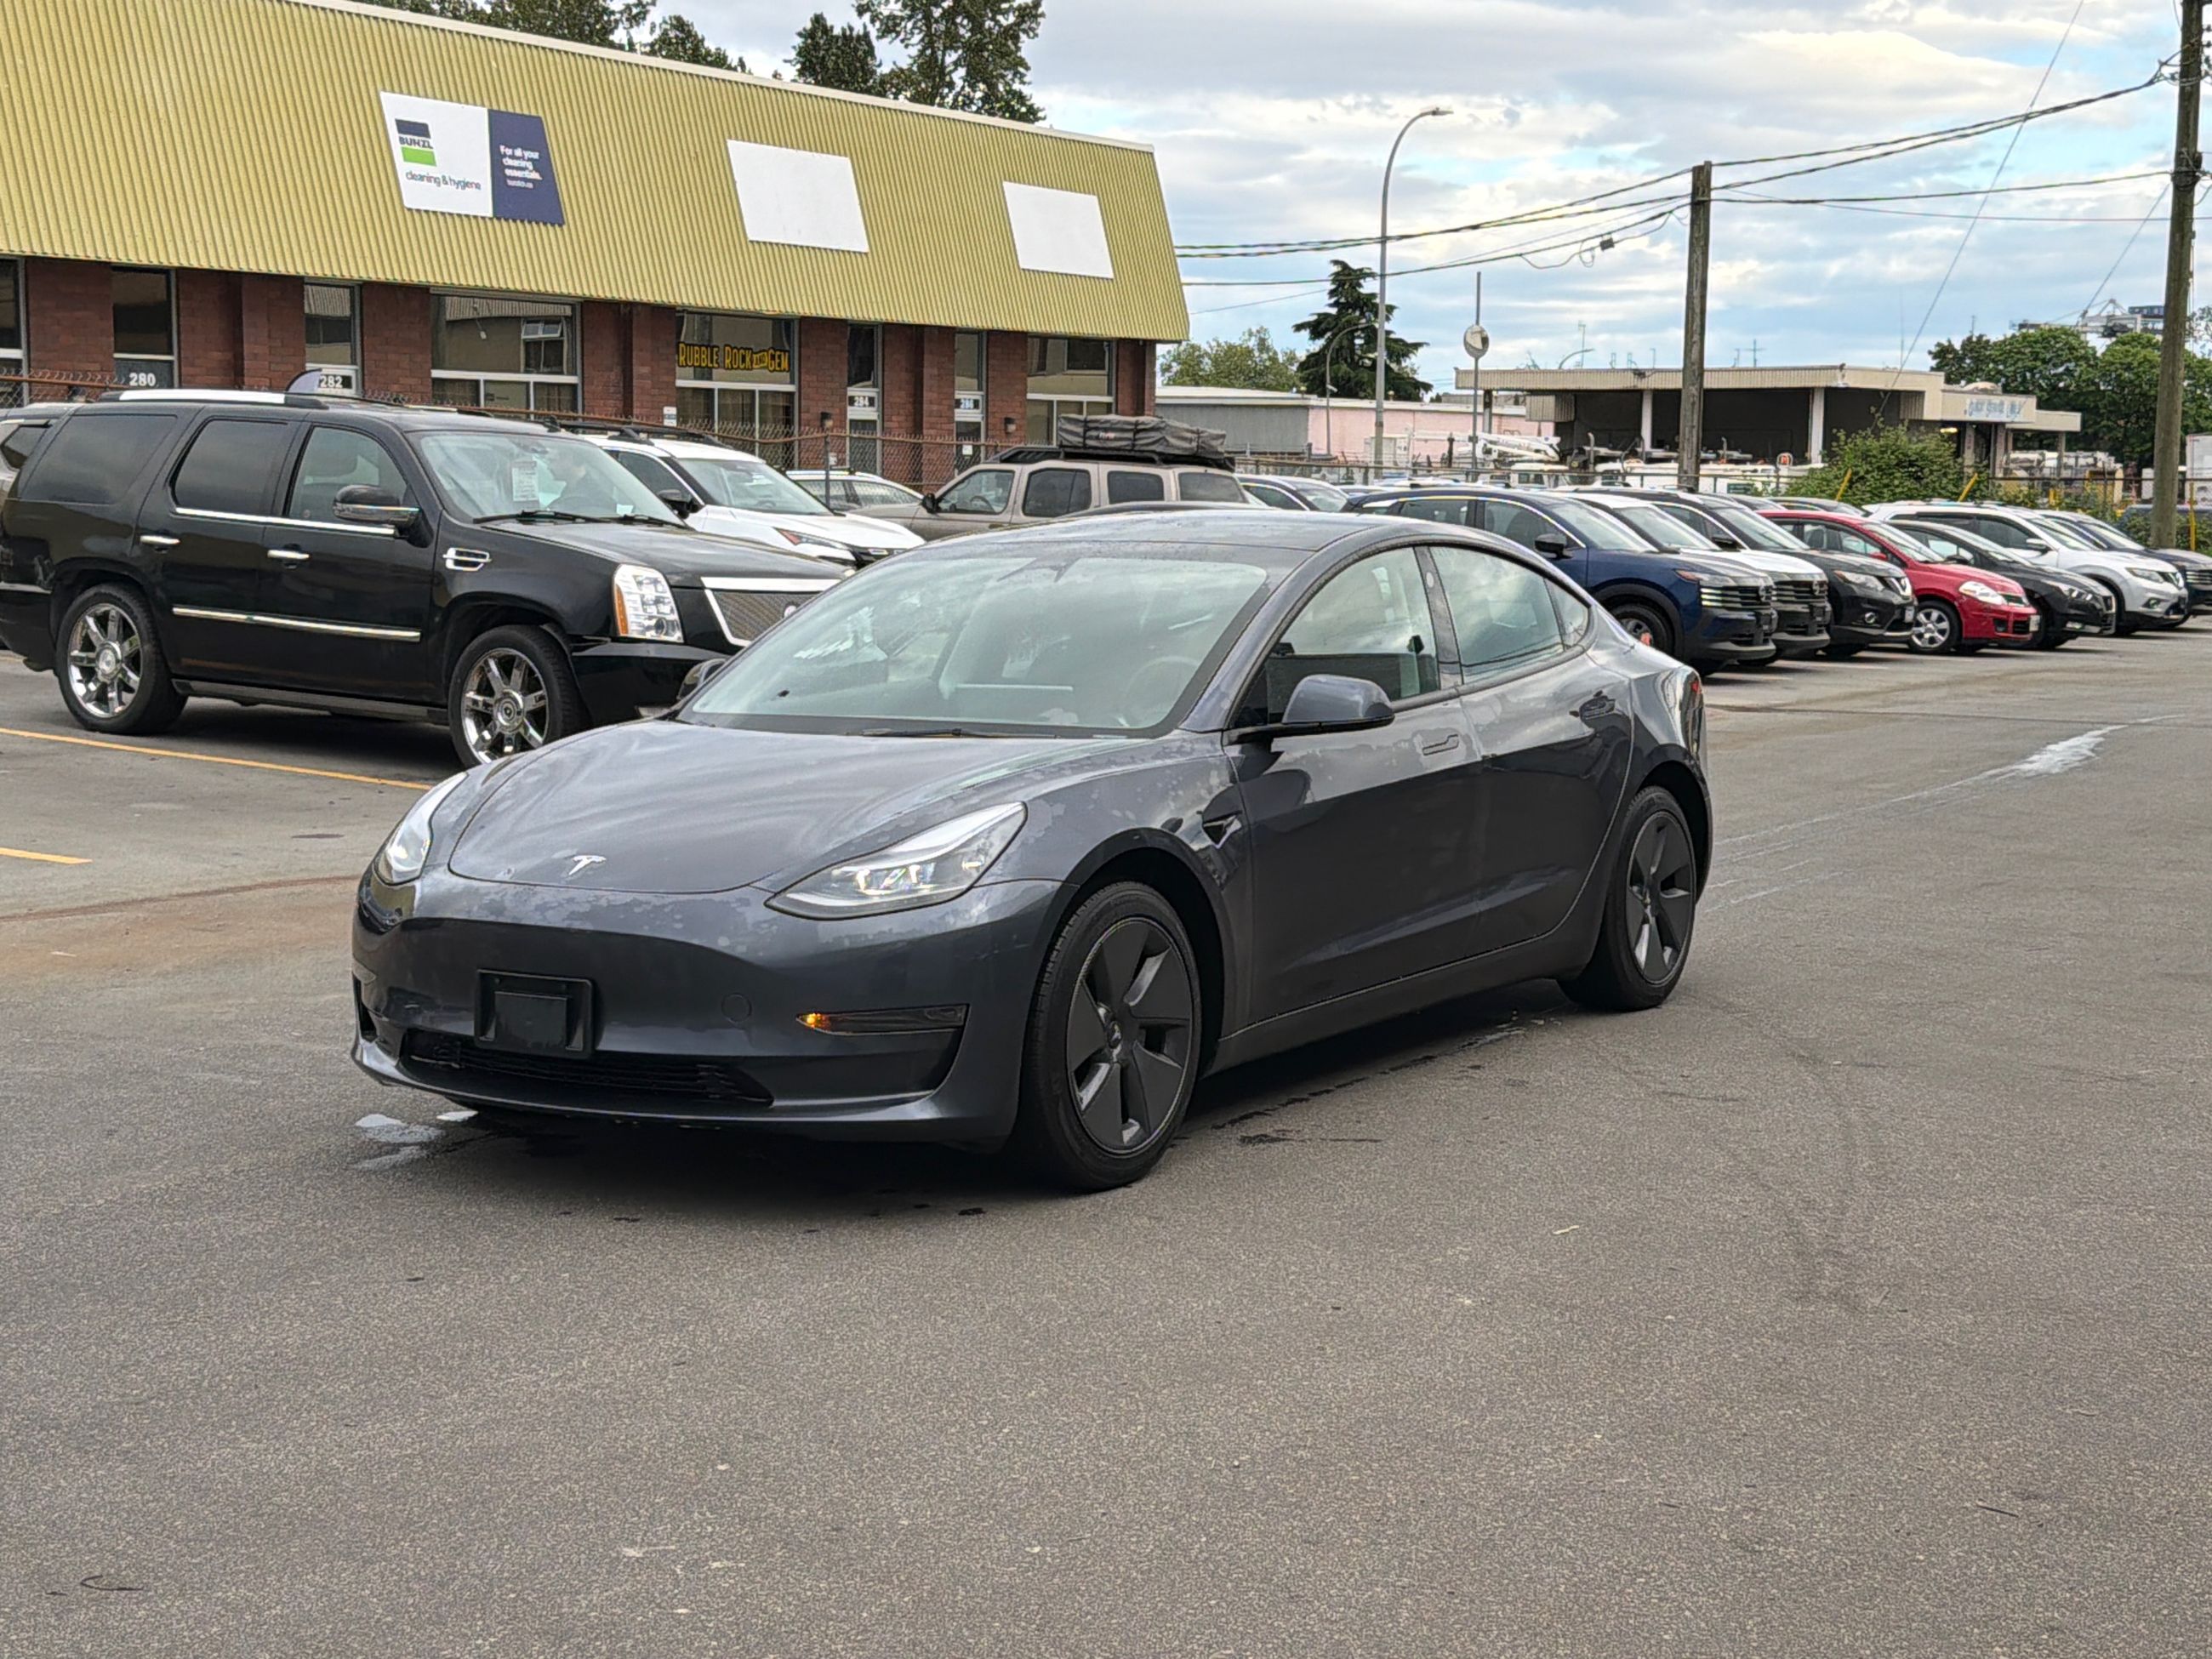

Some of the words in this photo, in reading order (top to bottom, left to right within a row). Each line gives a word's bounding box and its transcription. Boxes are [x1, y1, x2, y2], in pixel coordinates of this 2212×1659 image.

[398, 136, 433, 150] BUNZL
[499, 145, 513, 156] For
[514, 147, 523, 157] all
[522, 150, 539, 161] your
[502, 157, 533, 171] cleaning
[405, 170, 441, 187] cleaning
[442, 174, 448, 185] &
[448, 175, 482, 191] hygiene
[677, 342, 720, 368] RUBBLE
[723, 345, 754, 370] ROCK
[767, 348, 790, 372] GEM
[128, 373, 156, 387] 280
[319, 375, 344, 389] 282
